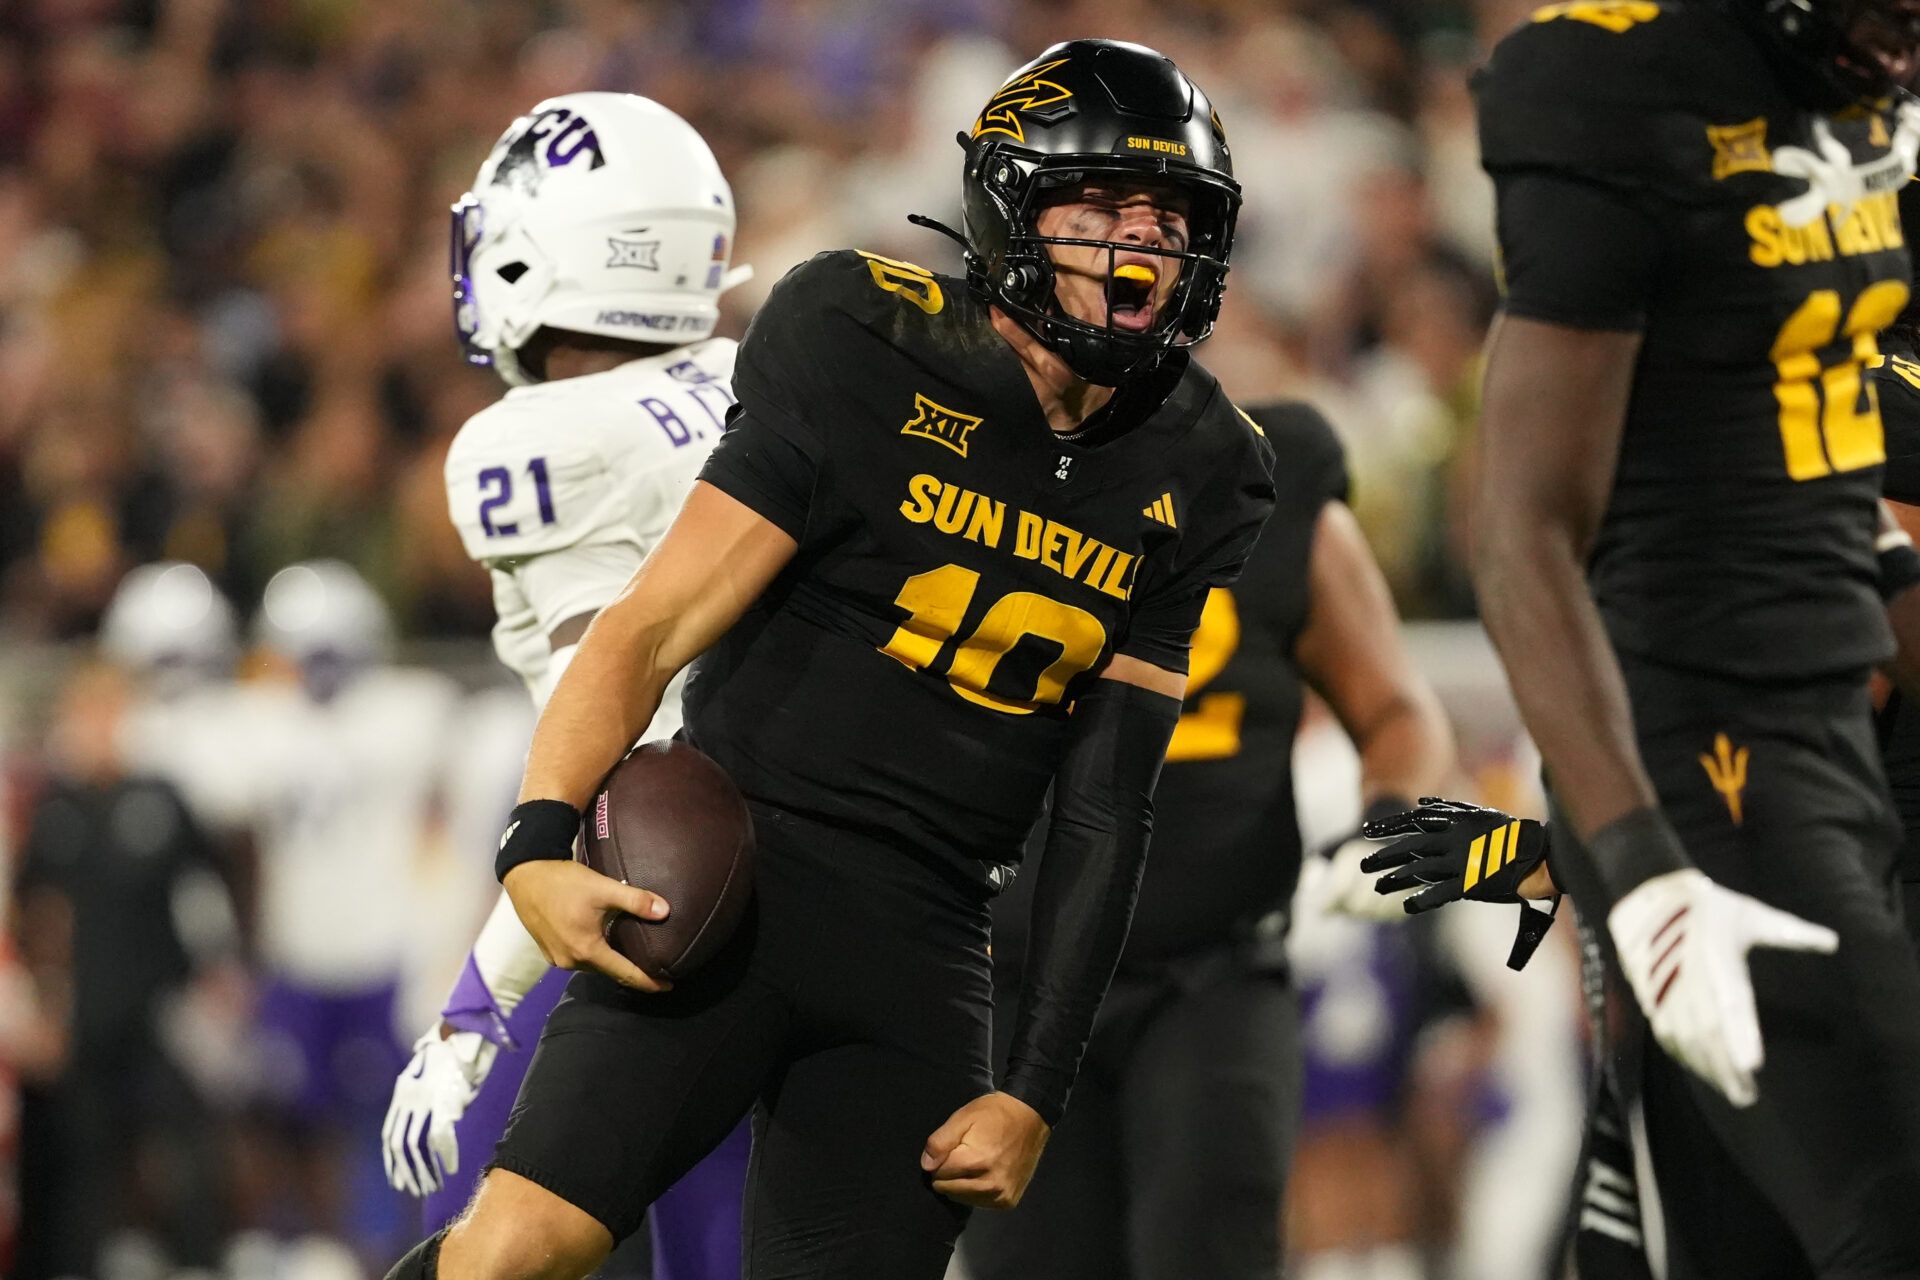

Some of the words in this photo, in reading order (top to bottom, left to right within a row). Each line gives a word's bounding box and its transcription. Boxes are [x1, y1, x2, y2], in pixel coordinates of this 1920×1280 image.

[1127, 136, 1150, 150] SUN
[1153, 140, 1186, 156] DEVILS
[1055, 469, 1068, 480] 42
[1059, 455, 1073, 467] PT
[478, 457, 556, 537] 21
[900, 474, 1006, 549] SUN
[1013, 510, 1144, 601] DEVIL
[876, 563, 1106, 715] 10
[596, 790, 609, 840] DIME
